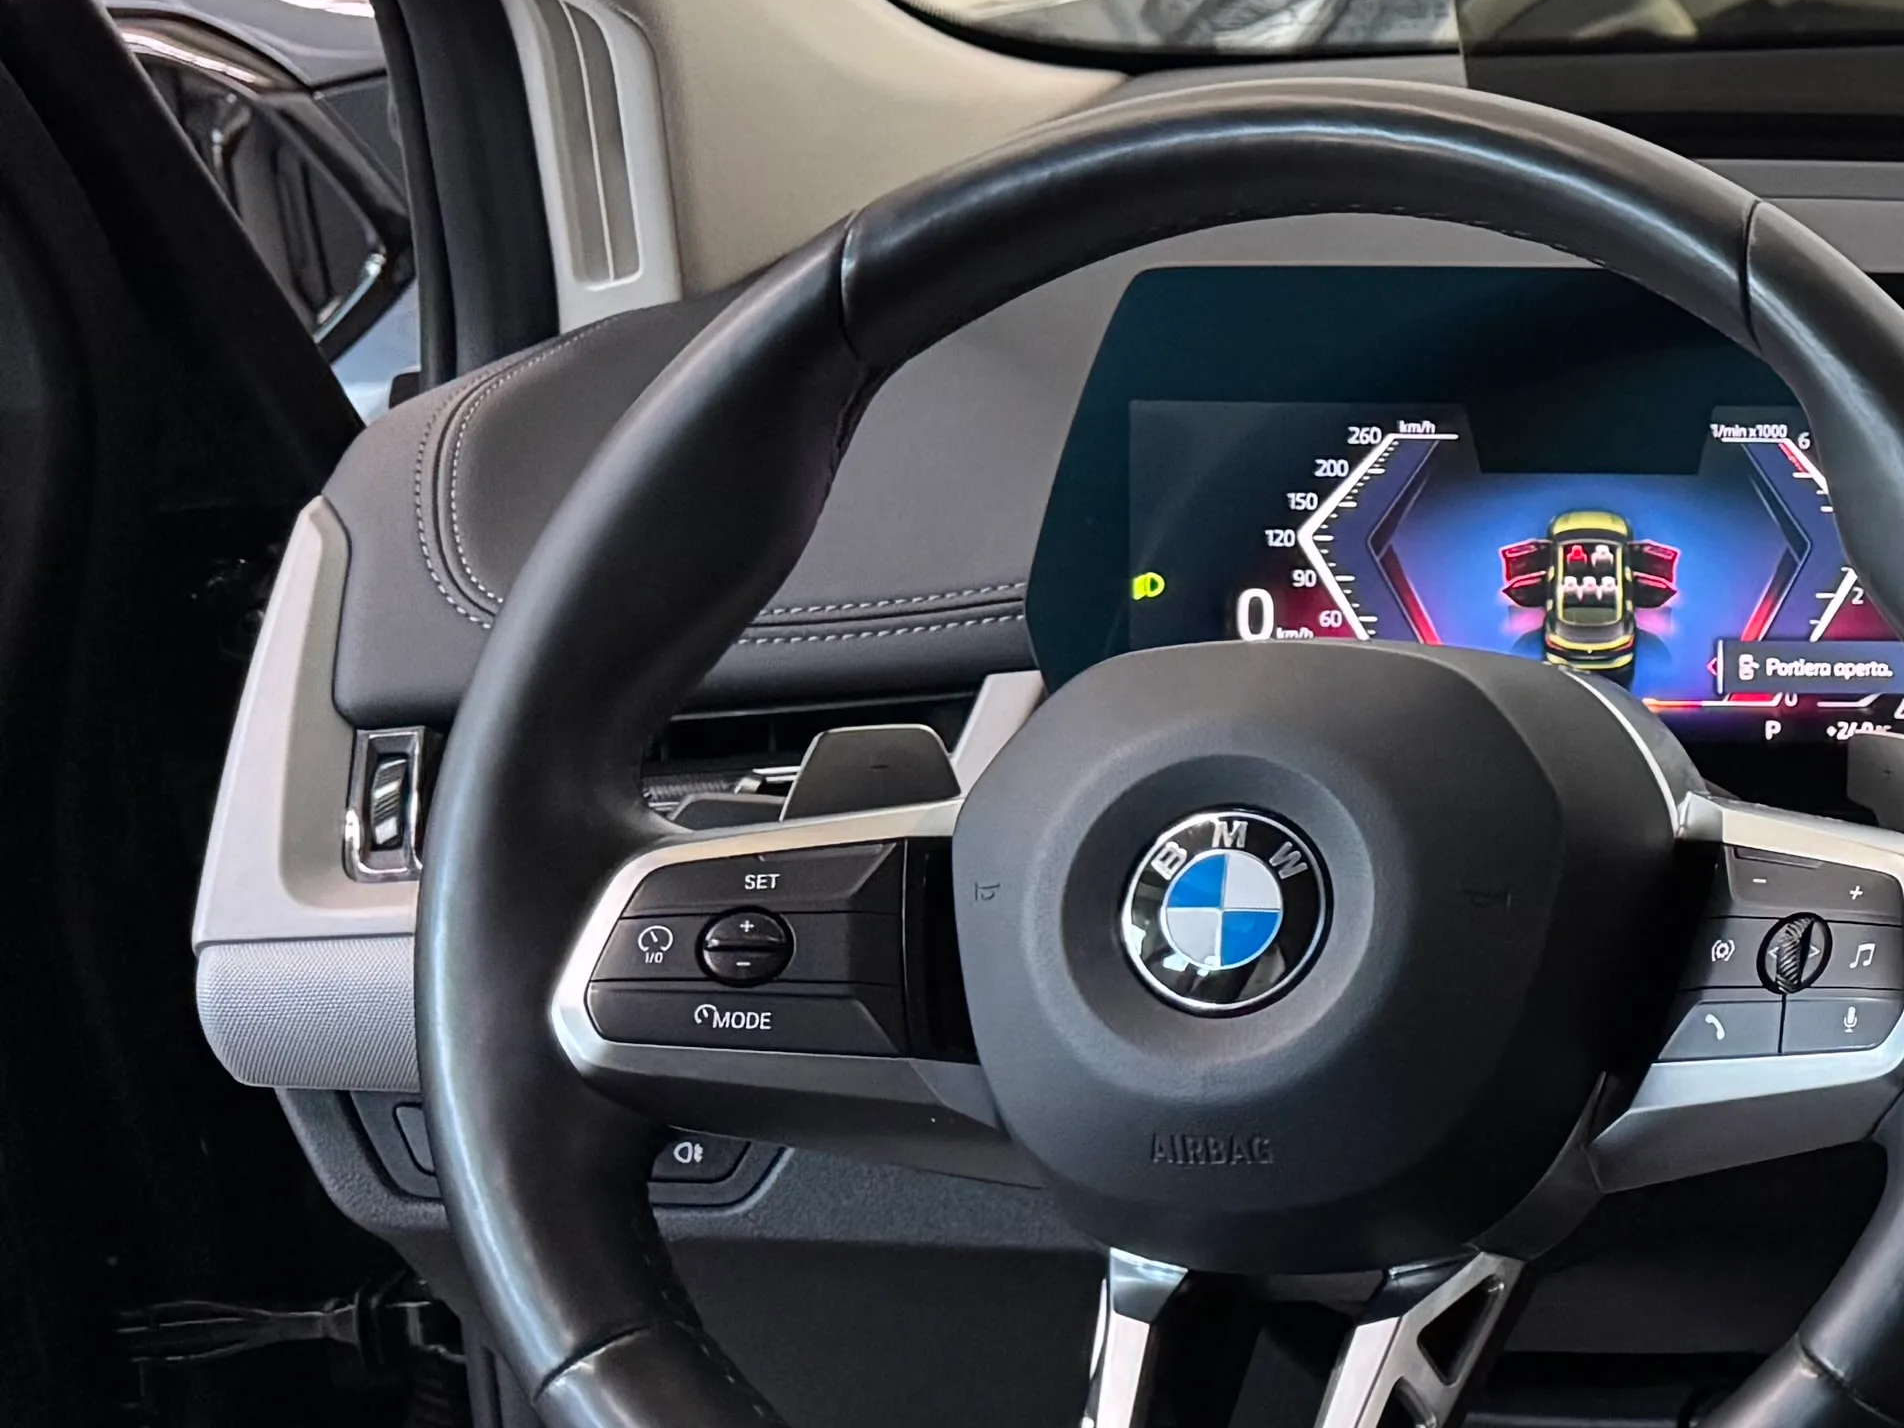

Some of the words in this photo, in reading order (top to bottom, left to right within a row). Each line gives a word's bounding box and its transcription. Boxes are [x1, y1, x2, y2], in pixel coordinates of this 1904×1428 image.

[1347, 426, 1383, 445] 260
[1397, 420, 1436, 434] km/h
[1797, 431, 1811, 450] 6
[1314, 459, 1349, 477] 200
[1286, 492, 1318, 510] 150
[1265, 529, 1295, 547] 120
[1292, 569, 1317, 587] 90
[1851, 586, 1864, 605] 2
[1237, 587, 1275, 641] 0
[1319, 610, 1342, 627] 60
[1766, 657, 1832, 677] Portiera
[1765, 719, 1782, 741] P
[1150, 819, 1308, 881] BMW
[744, 873, 781, 890] SET
[712, 1011, 772, 1030] MODE
[1149, 1130, 1274, 1166] AIRBAG
